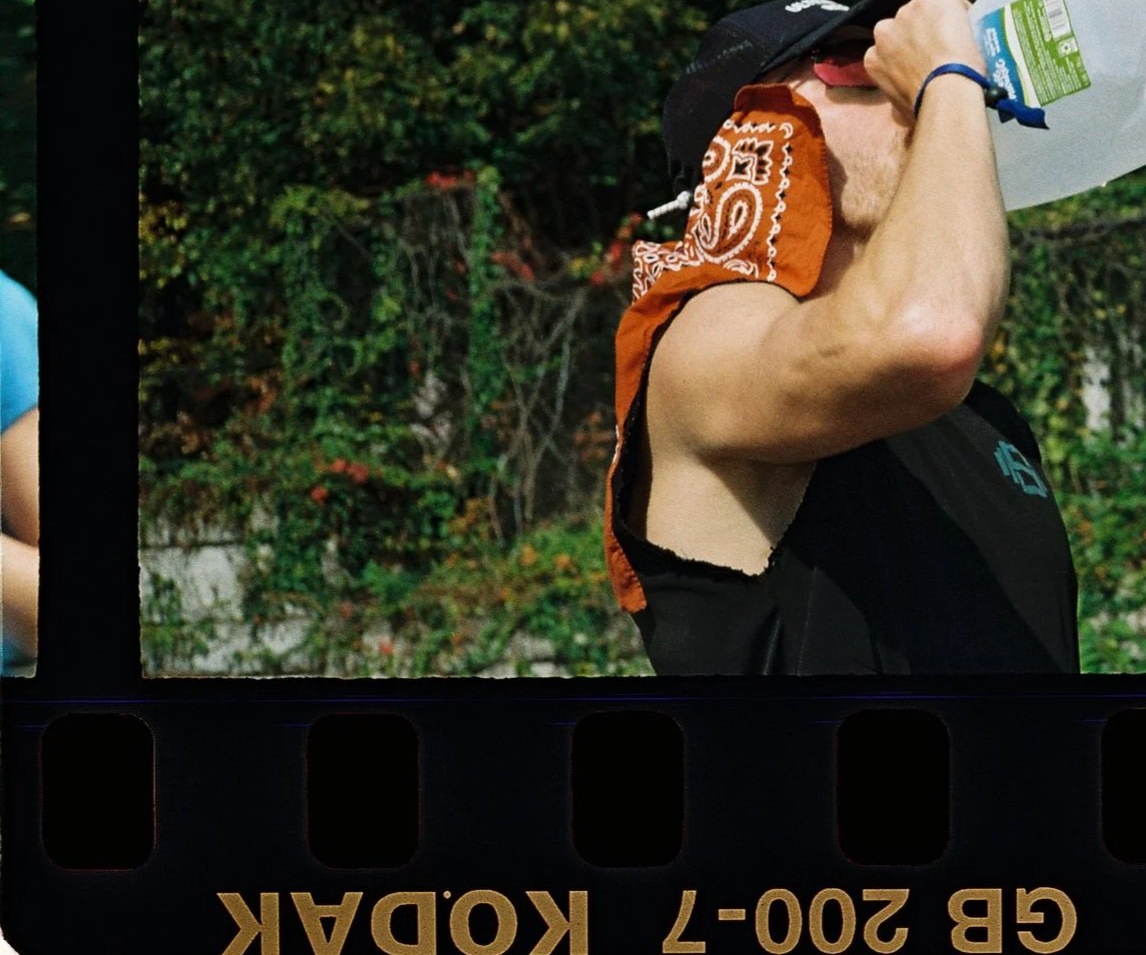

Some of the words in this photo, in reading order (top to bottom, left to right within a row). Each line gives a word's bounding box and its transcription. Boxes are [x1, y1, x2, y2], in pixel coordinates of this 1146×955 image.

[216, 890, 589, 955] KODAK
[661, 887, 911, 955] 200-7
[948, 887, 1079, 955] GB
